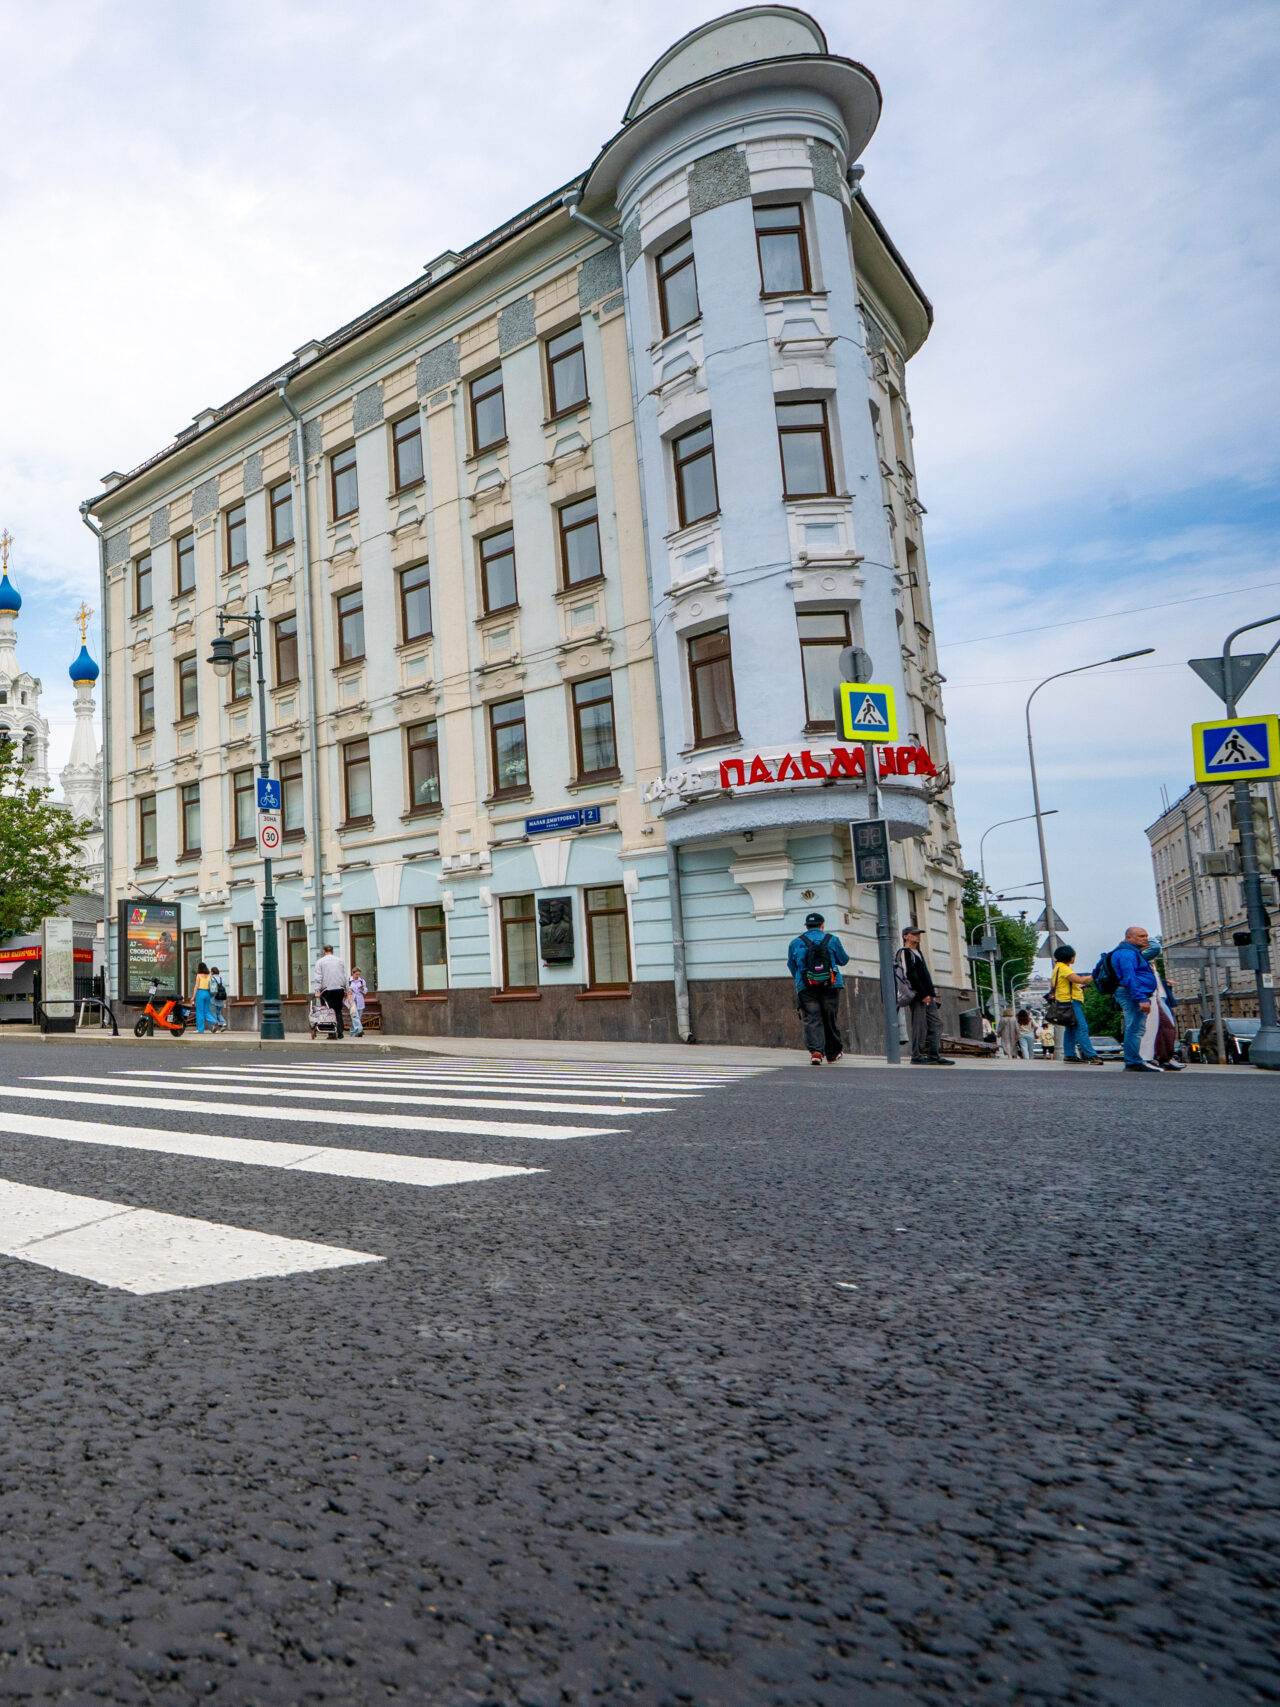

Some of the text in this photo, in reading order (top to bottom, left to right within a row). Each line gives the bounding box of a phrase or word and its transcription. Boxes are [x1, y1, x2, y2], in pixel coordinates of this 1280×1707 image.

[546, 814, 576, 823] ДМИТРОВКА
[587, 810, 593, 819] 2
[265, 832, 276, 841] 30
